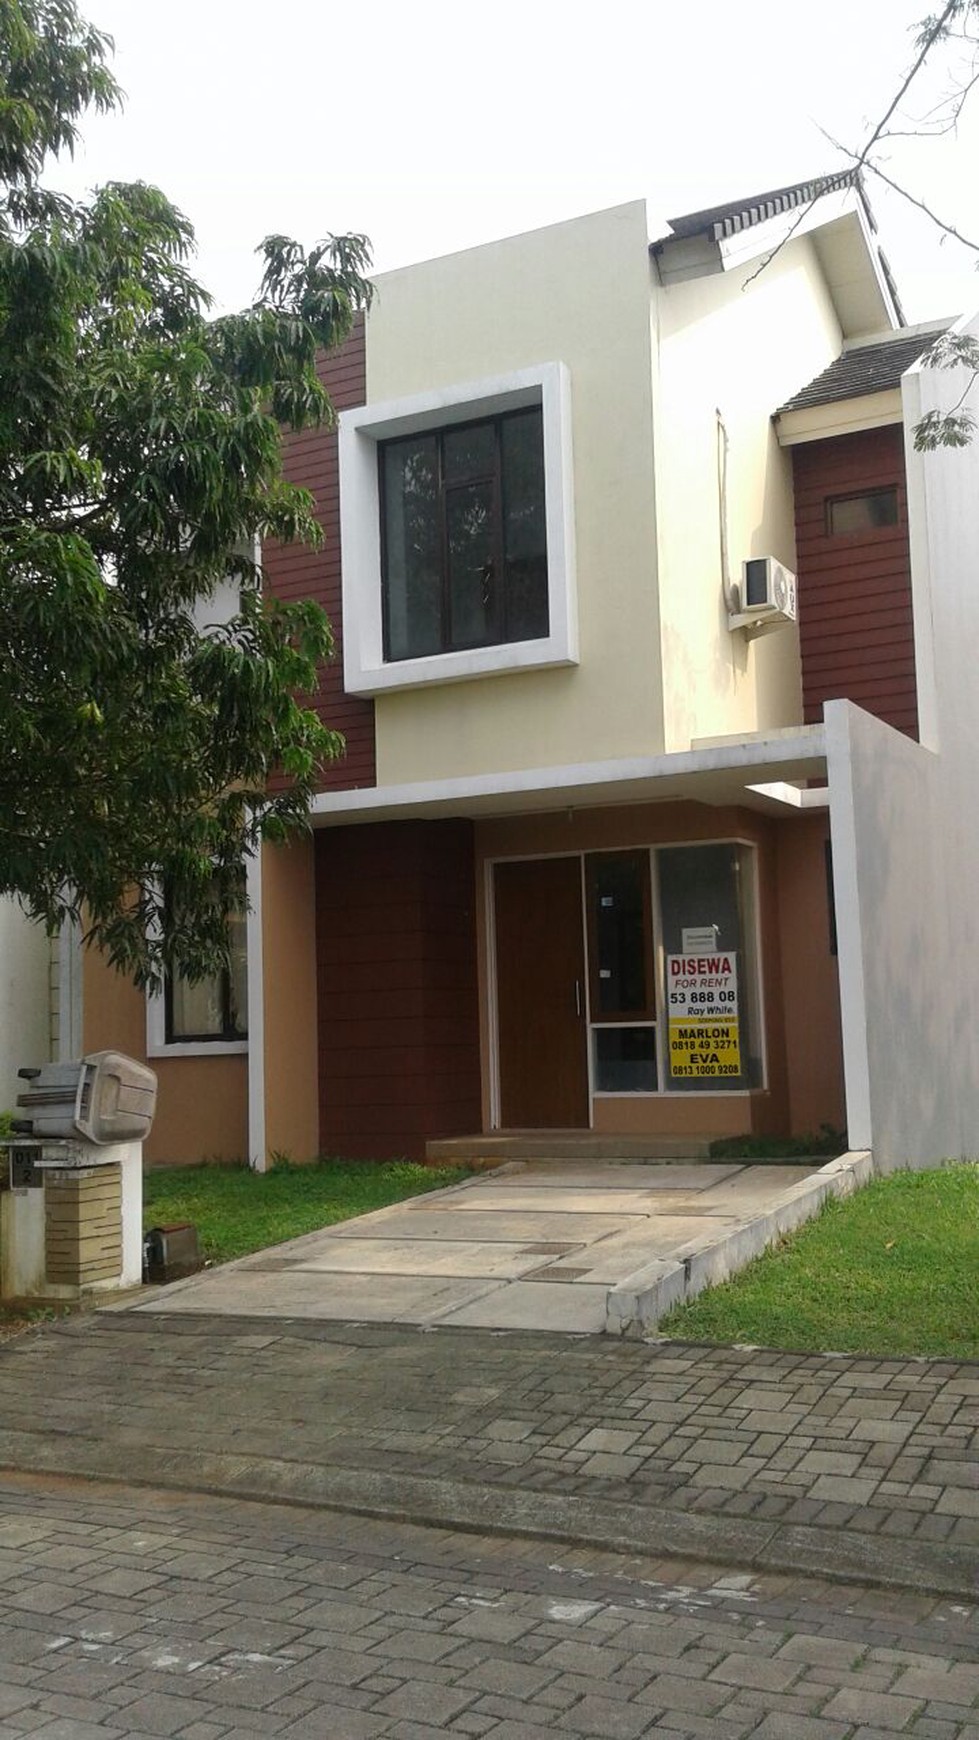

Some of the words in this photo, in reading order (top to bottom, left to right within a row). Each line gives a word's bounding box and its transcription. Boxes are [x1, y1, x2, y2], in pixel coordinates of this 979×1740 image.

[671, 957, 732, 976] DISEWA
[675, 978, 697, 989] FOR
[700, 977, 729, 988] RENT
[670, 992, 686, 1004] 53
[690, 991, 714, 1003] 888
[719, 990, 735, 1002] 08
[687, 1006, 705, 1016] Ray
[678, 1029, 729, 1039] MARLON
[671, 1041, 695, 1050] 0818
[699, 1041, 711, 1050] 49
[713, 1040, 737, 1049] 3271
[690, 1053, 720, 1064] EVA
[672, 1066, 693, 1075] 0813
[696, 1066, 716, 1074] 1000
[717, 1065, 739, 1074] 9208
[22, 1169, 32, 1182] 2
